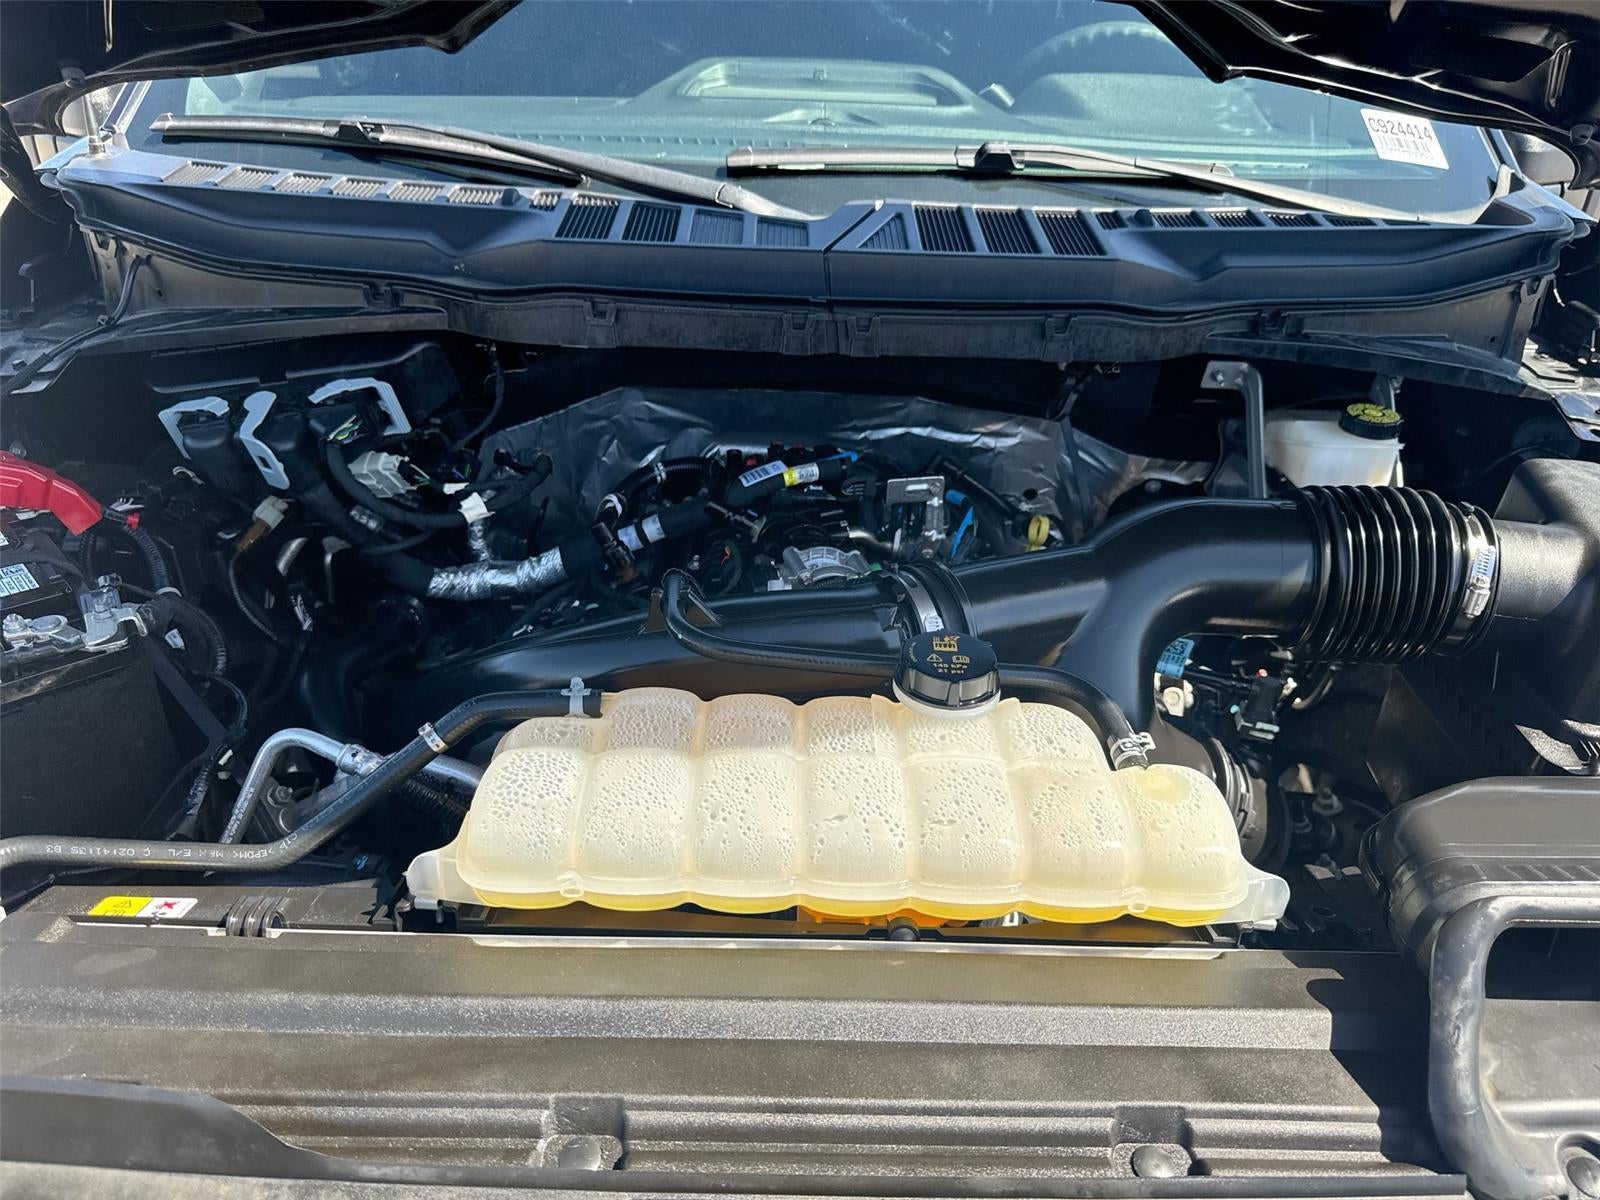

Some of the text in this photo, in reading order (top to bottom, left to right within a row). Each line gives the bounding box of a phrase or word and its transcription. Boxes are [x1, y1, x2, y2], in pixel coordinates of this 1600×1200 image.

[1368, 117, 1433, 142] C924414
[46, 844, 62, 854] B3
[167, 848, 192, 857] E/L
[232, 847, 274, 859] >EPDM<
